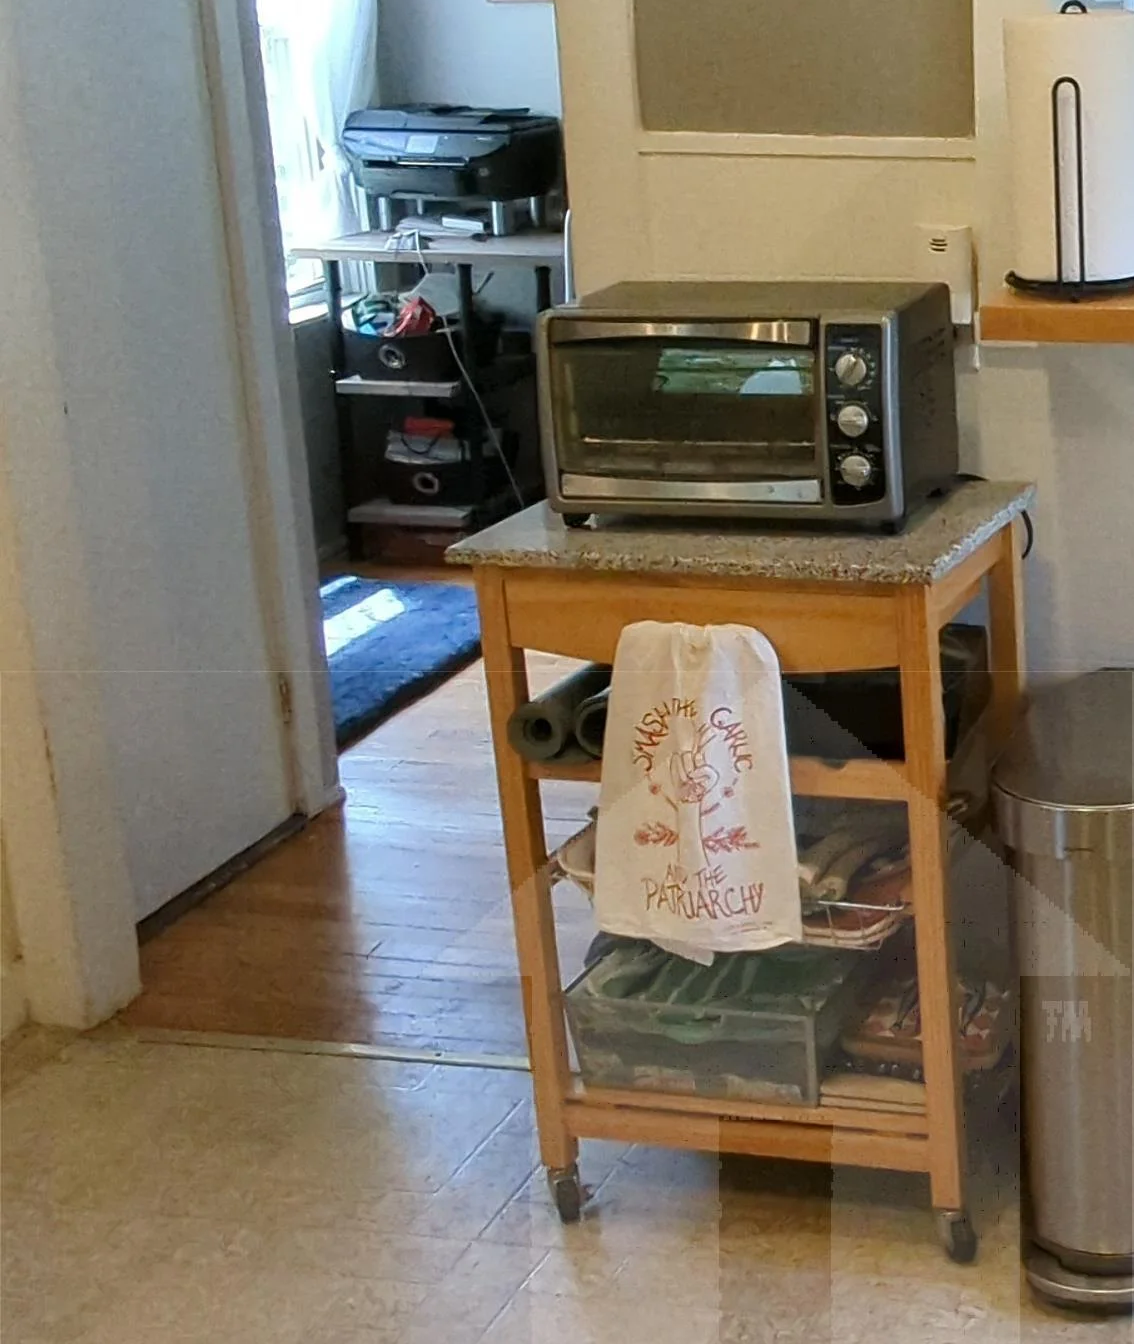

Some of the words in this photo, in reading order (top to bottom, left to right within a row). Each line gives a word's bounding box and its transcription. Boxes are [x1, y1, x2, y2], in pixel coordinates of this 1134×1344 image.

[632, 700, 670, 772] SMASH
[710, 706, 753, 773] GARLIC
[692, 864, 729, 889] THE
[641, 877, 764, 919] PATRIARCHY
